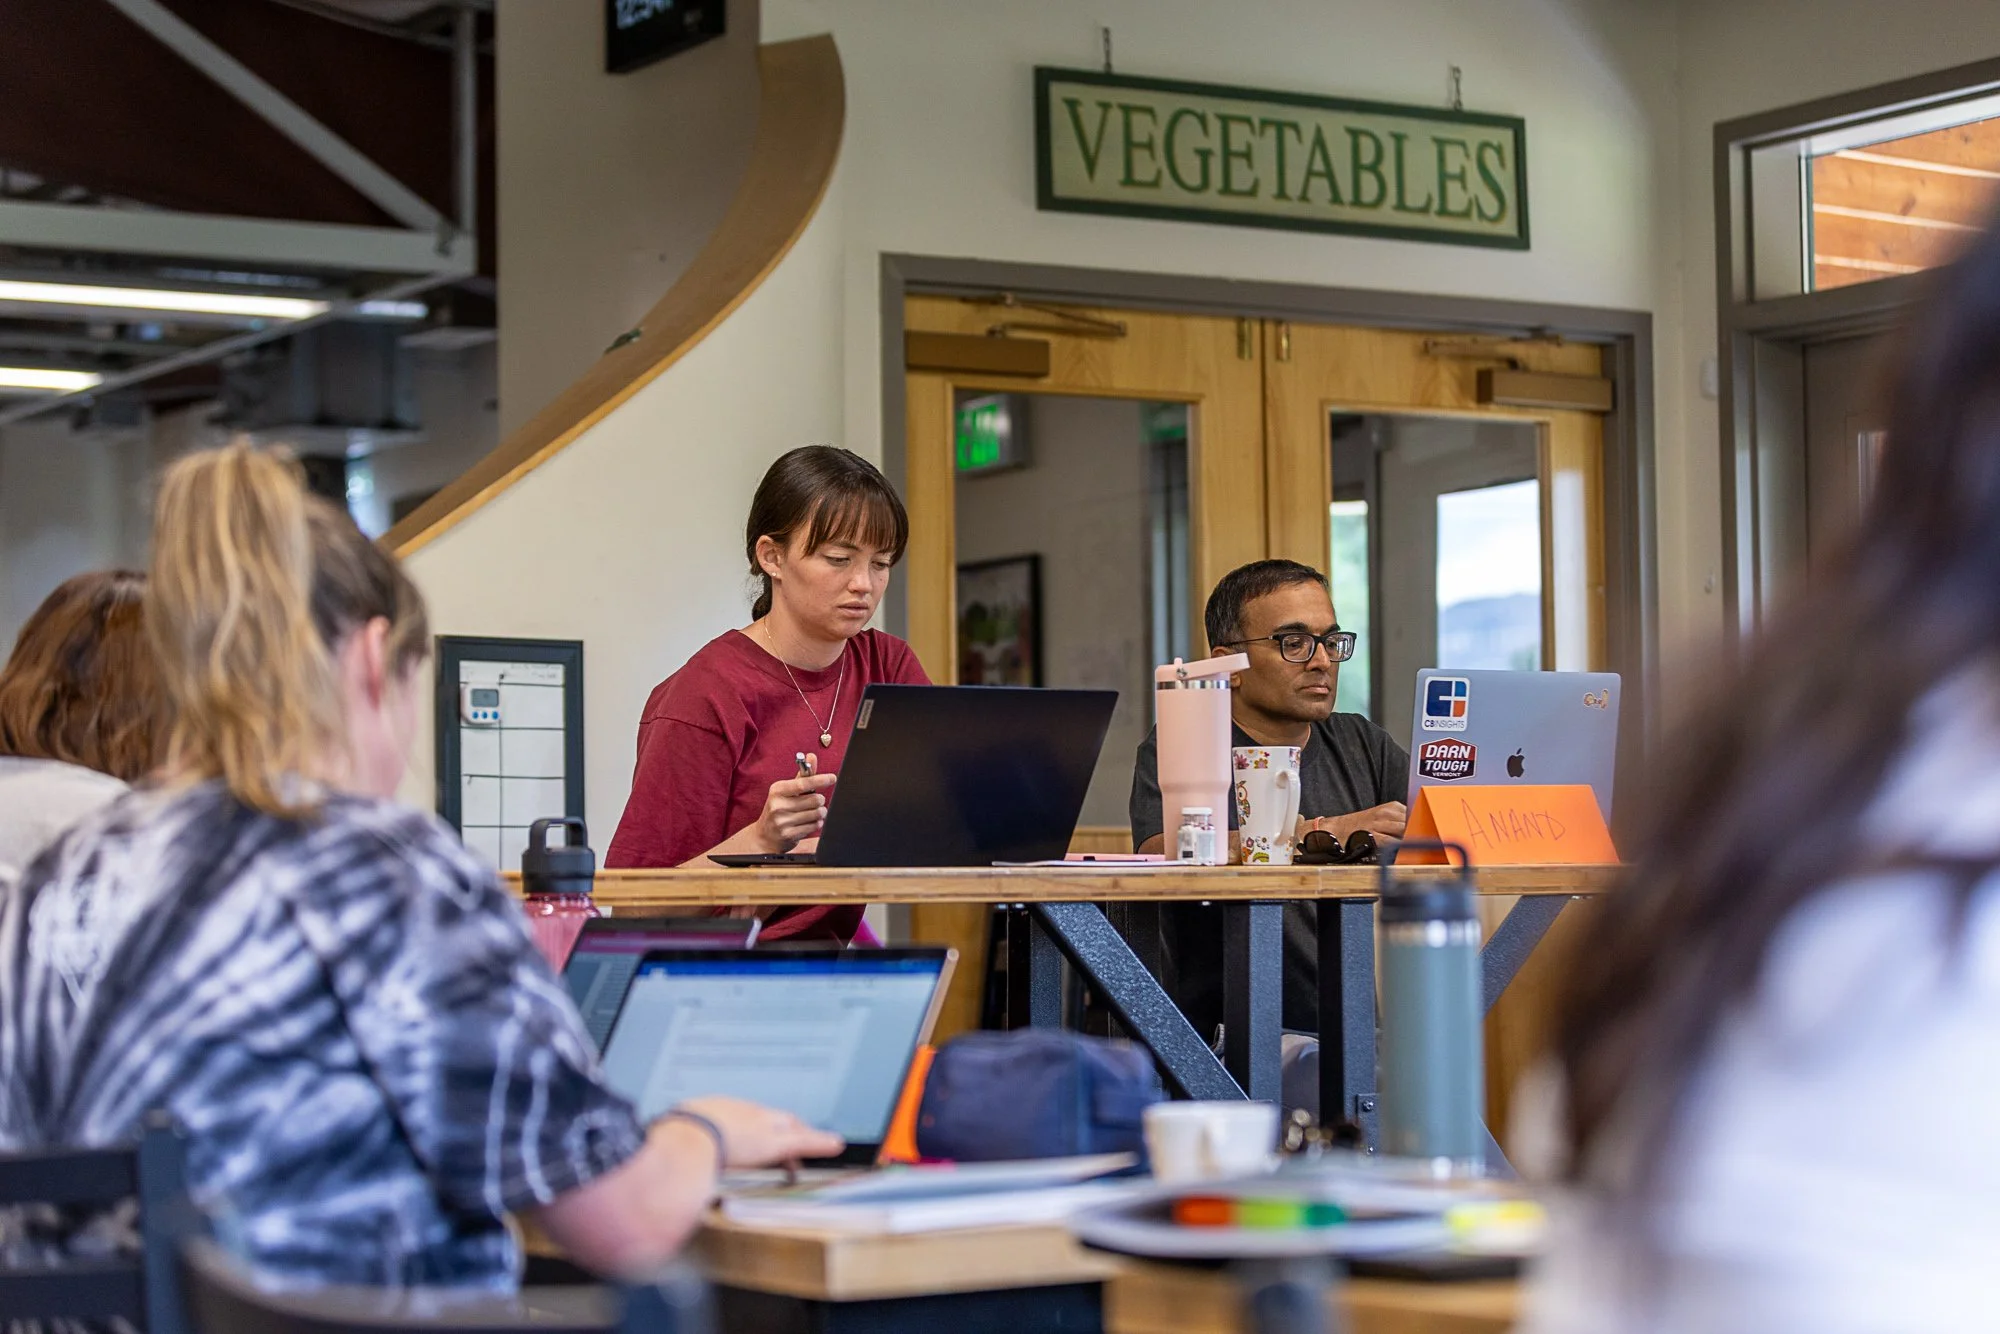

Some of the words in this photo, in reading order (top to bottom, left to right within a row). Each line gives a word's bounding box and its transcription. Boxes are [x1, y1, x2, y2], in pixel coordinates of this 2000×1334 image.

[1063, 98, 1507, 225] VEGETABLES
[1425, 744, 1471, 758] DARN
[1425, 760, 1469, 771] TOUGH
[1461, 798, 1566, 849] ANAND
